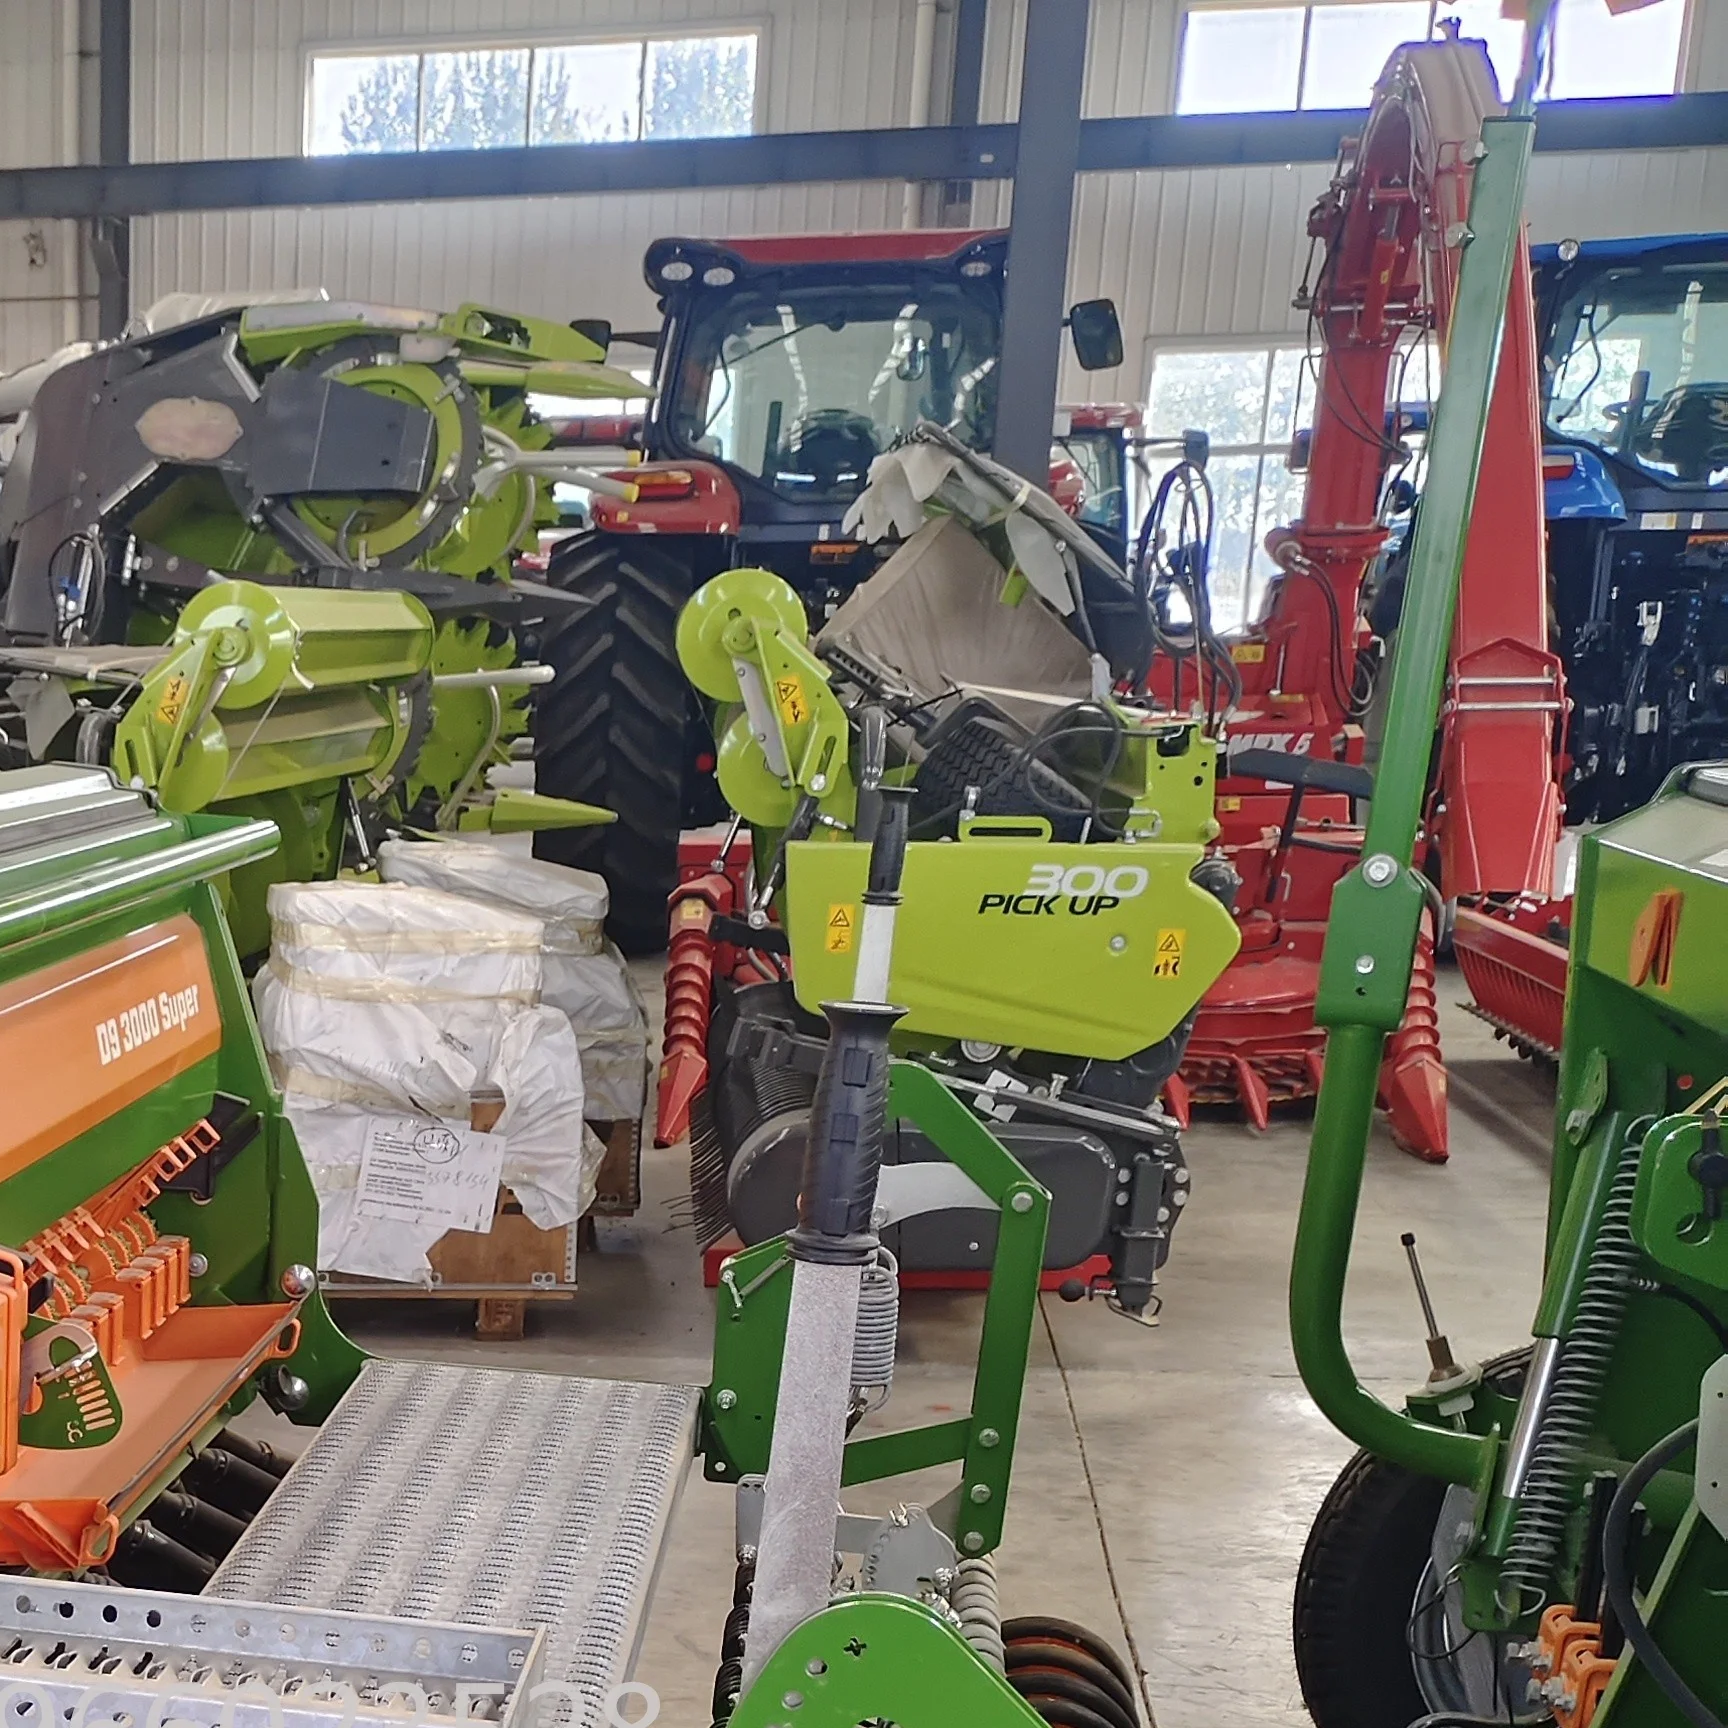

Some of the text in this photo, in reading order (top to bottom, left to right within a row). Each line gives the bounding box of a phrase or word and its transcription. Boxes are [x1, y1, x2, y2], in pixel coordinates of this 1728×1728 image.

[1023, 863, 1149, 898] 300
[978, 893, 1120, 915] PICK UP
[95, 983, 199, 1066] D9 3000 Super
